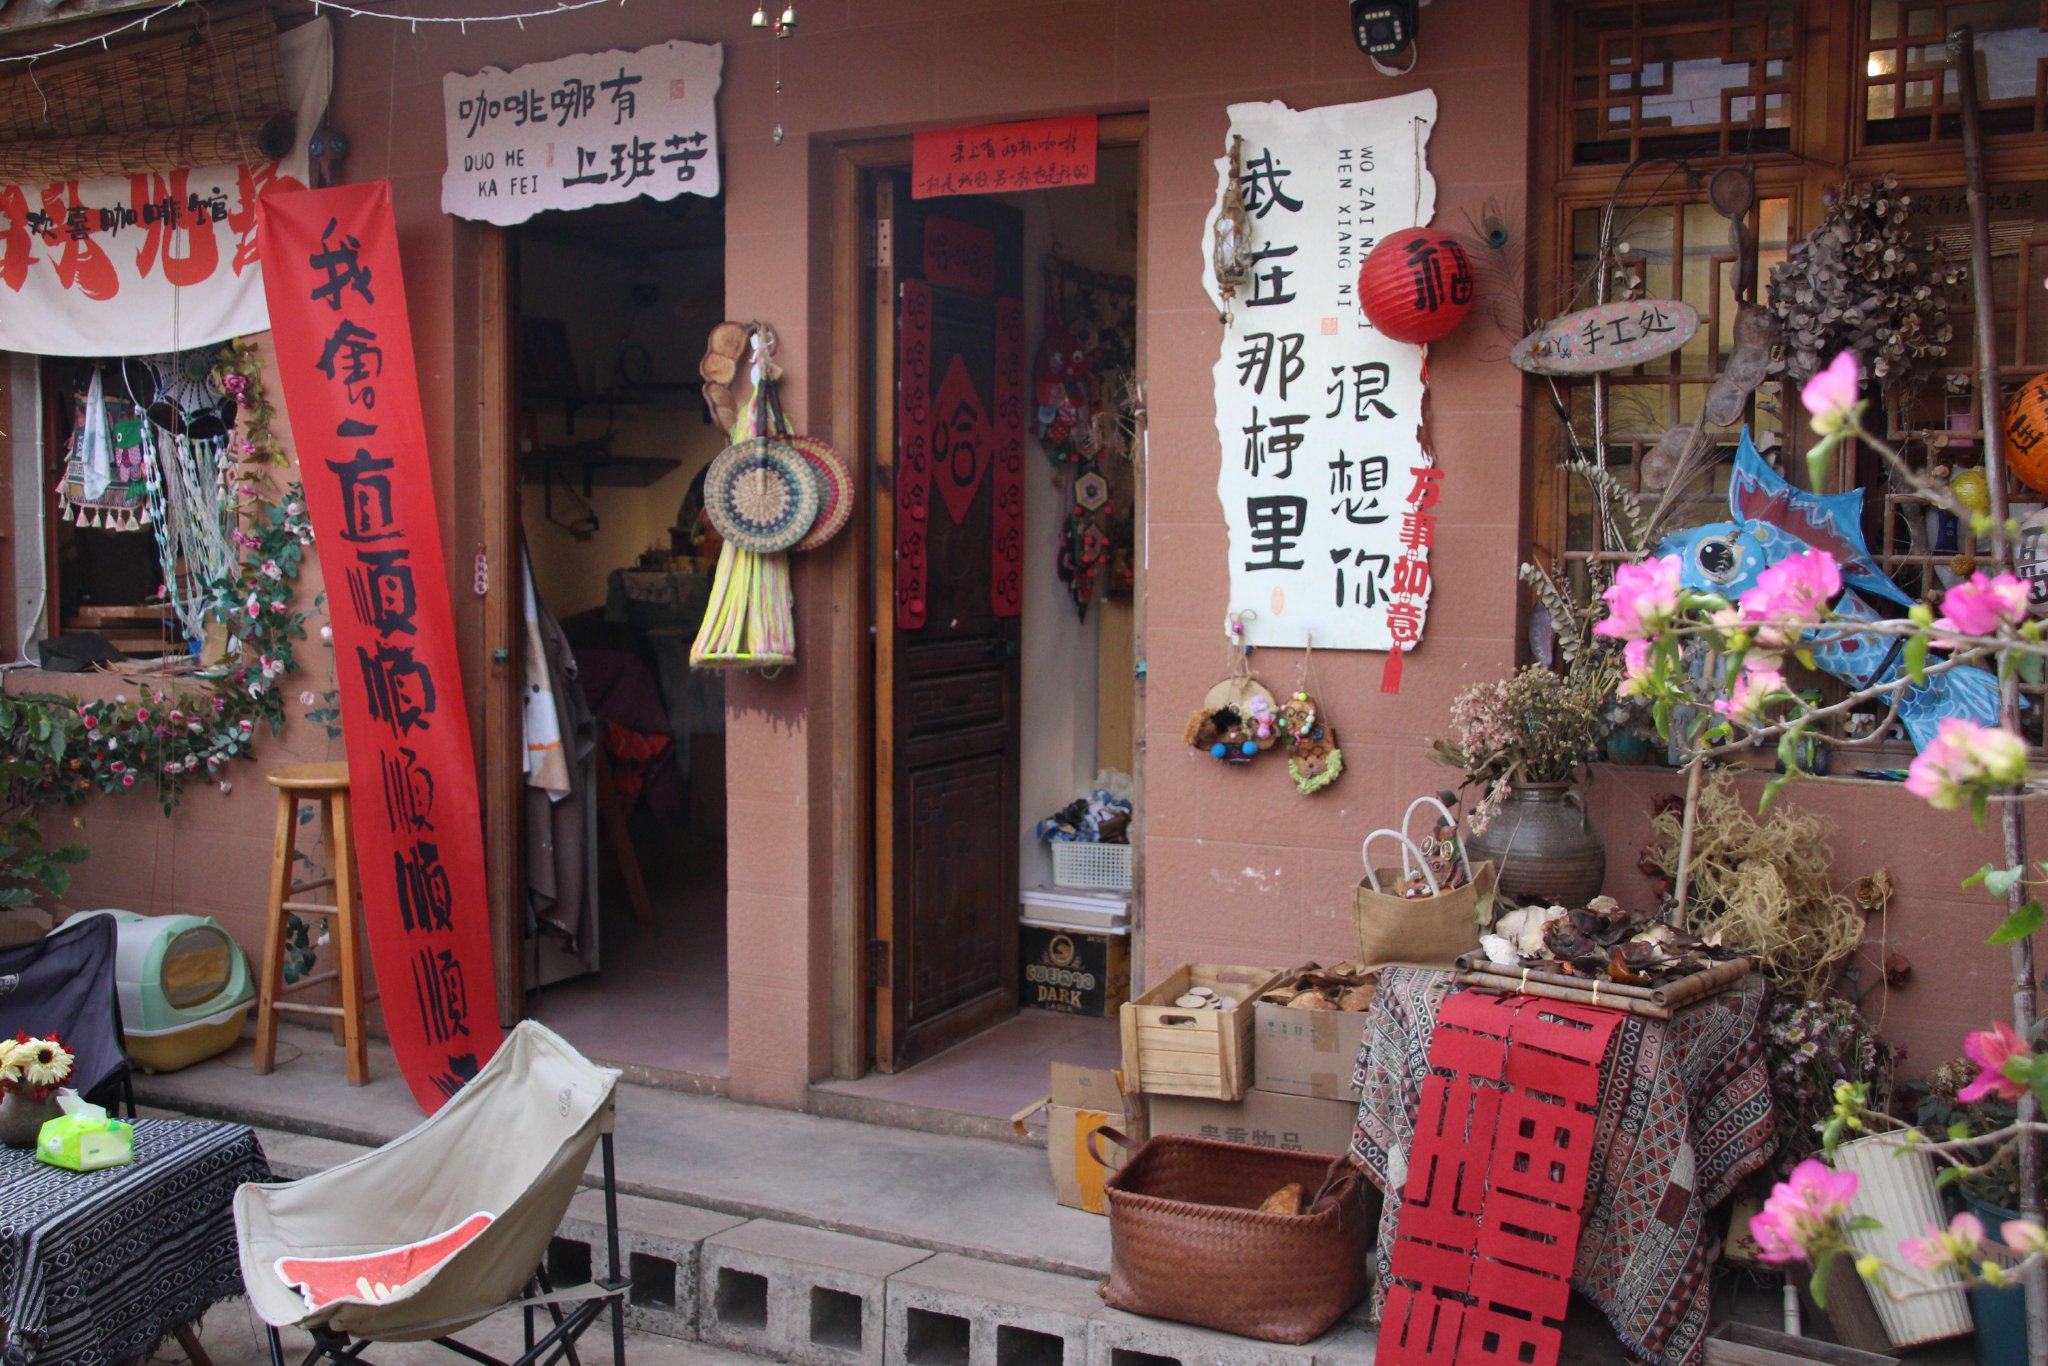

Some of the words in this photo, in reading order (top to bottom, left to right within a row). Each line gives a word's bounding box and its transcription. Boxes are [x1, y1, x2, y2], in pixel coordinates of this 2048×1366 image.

[458, 67, 643, 139] 咖啡哪有
[464, 151, 495, 172] DUO
[505, 149, 525, 167] HE
[562, 131, 708, 188] 上班苦
[1338, 149, 1352, 189] HEN
[1360, 146, 1375, 172] WO
[478, 179, 498, 197] KA
[511, 175, 538, 197] FEI
[1359, 186, 1375, 225] ZAI
[26, 187, 228, 241] 欢喜咖啡馆
[1337, 204, 1352, 270] XIANG
[1337, 284, 1352, 308] NI
[1404, 238, 1474, 313] 福
[1582, 306, 1676, 354] 手工处
[1325, 361, 1398, 609] 很想你
[1386, 467, 1445, 643] 万事如意
[1038, 985, 1082, 1009] DARK
